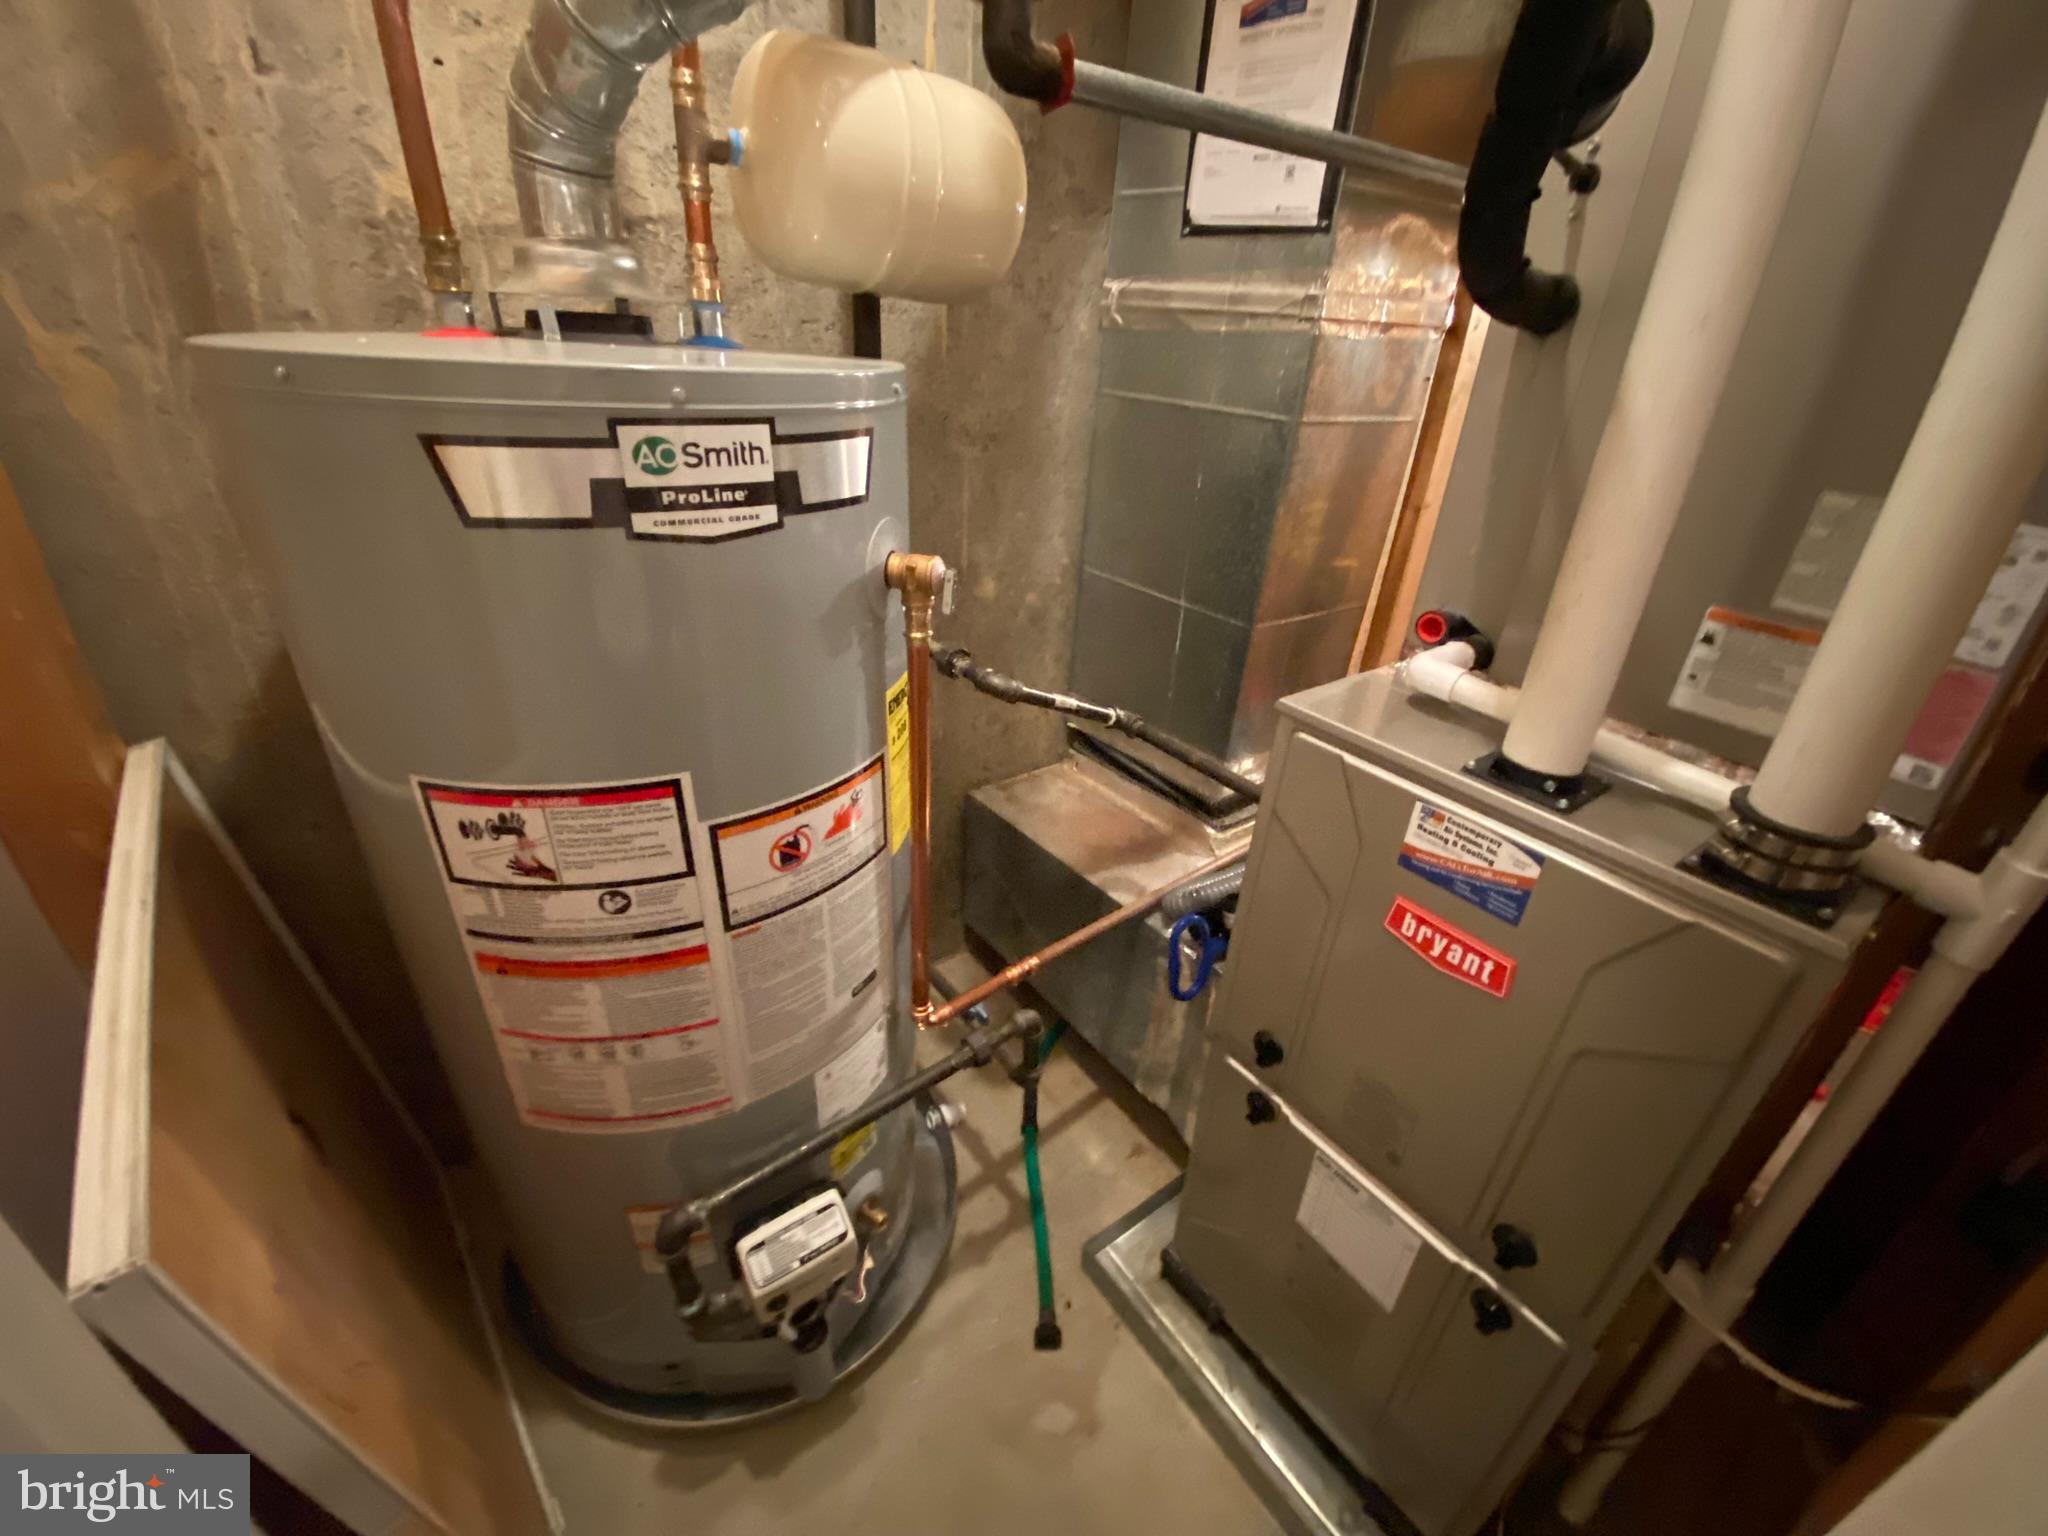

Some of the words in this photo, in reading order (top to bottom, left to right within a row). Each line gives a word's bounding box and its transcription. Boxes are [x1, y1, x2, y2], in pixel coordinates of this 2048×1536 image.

[681, 441, 765, 468] Smith
[661, 487, 746, 506] ProLine
[653, 517, 724, 528] COMMERCIAL
[729, 513, 761, 522] GRADE
[1416, 823, 1450, 846] Heating
[1460, 843, 1496, 868] Cooling
[1446, 816, 1503, 849] Contemporary
[1400, 912, 1496, 986] bryant
